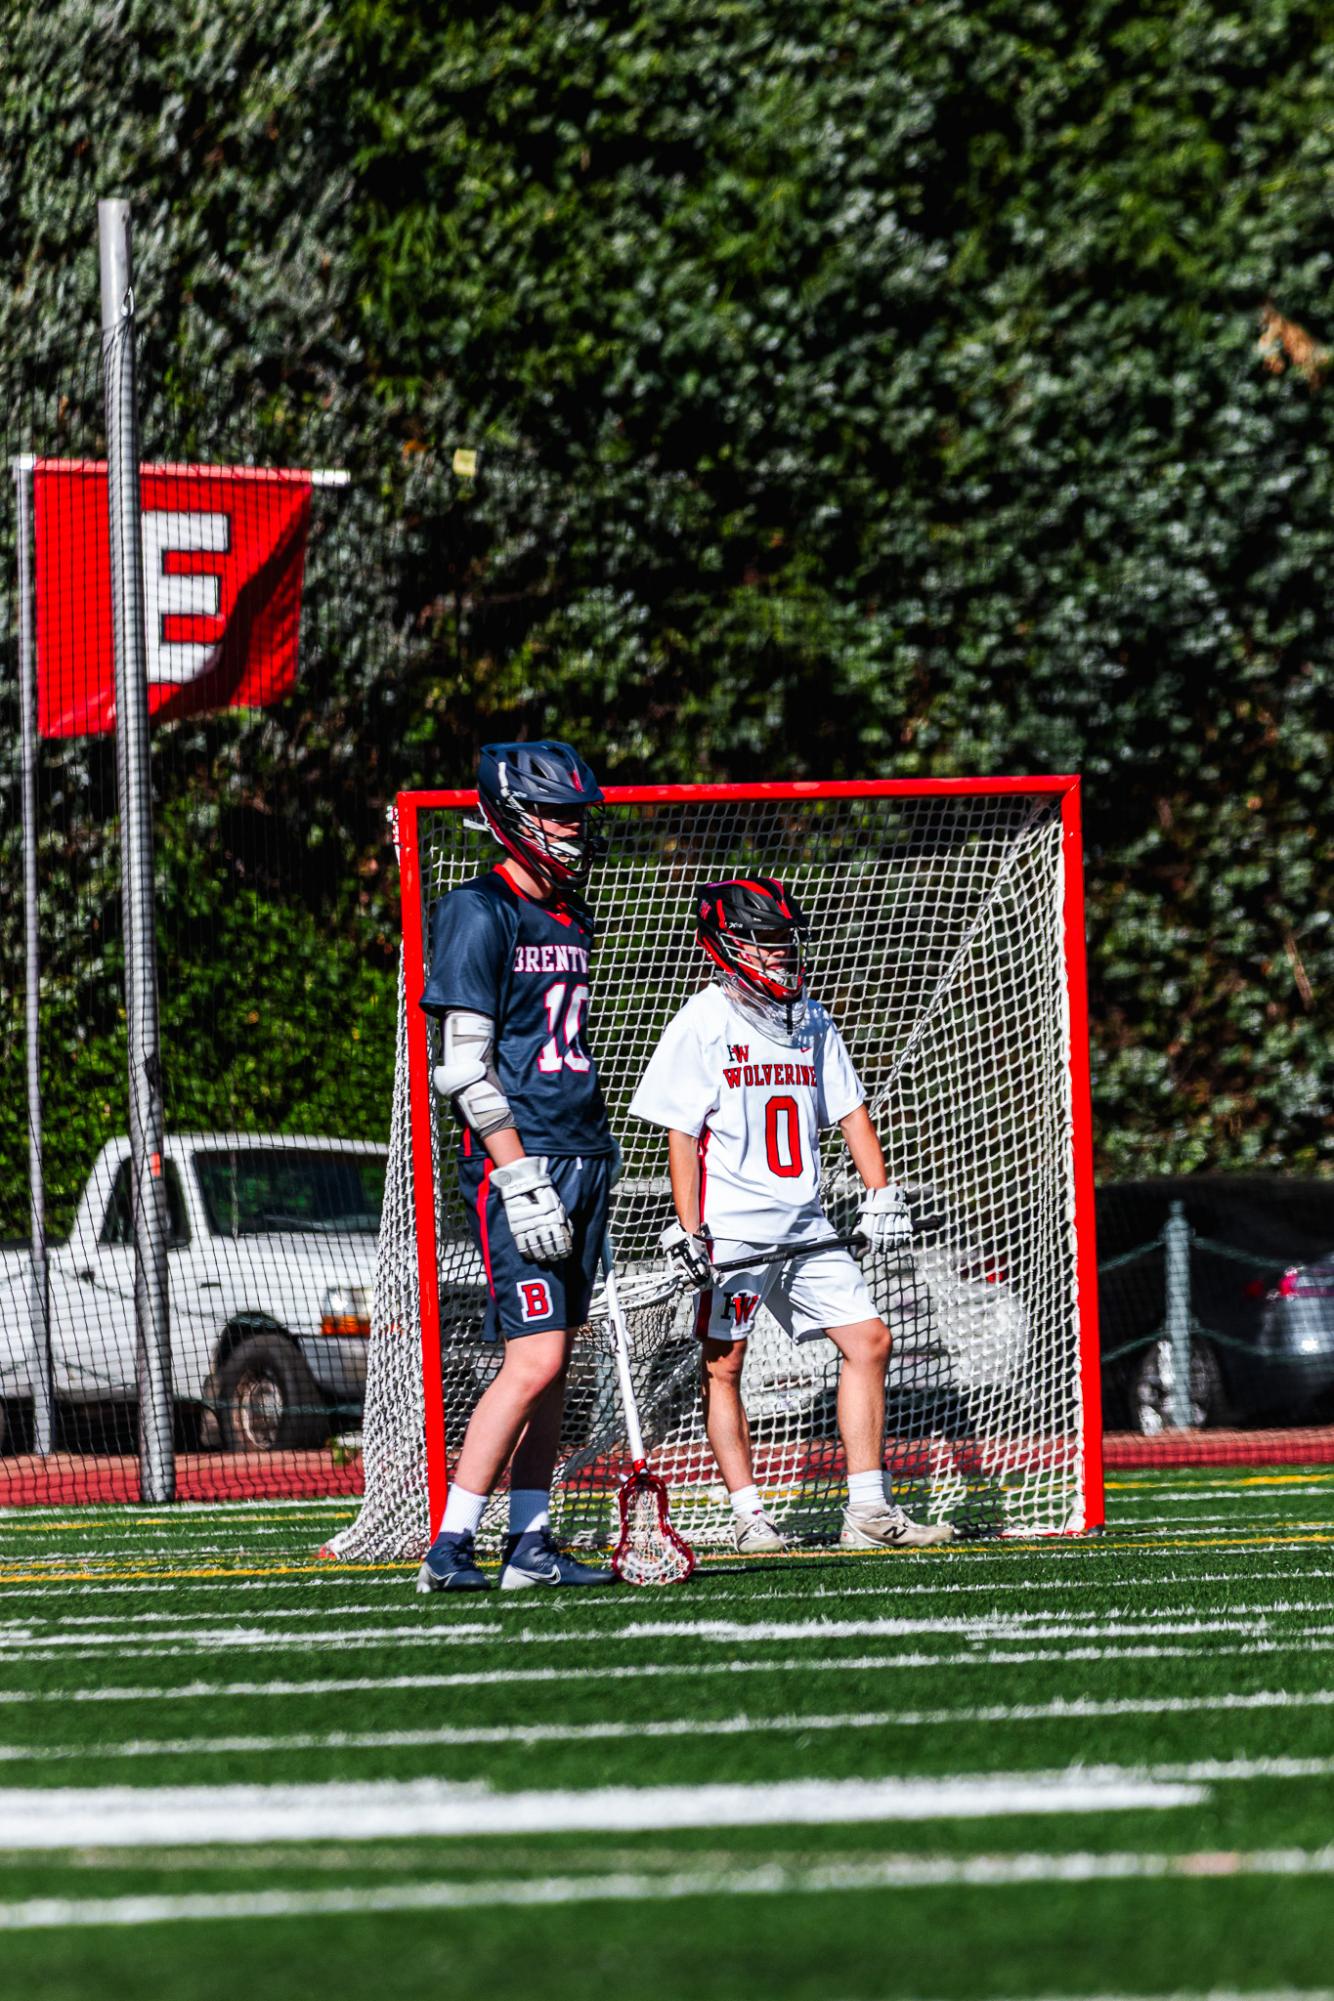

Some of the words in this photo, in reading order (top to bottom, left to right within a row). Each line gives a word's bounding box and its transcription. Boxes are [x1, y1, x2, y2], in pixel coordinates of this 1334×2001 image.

[141, 511, 230, 684] E
[538, 981, 591, 1073] 10
[723, 1063, 818, 1089] WOLVERINE
[765, 1095, 804, 1178] 0
[516, 1278, 554, 1323] B
[720, 1291, 760, 1326] HW
